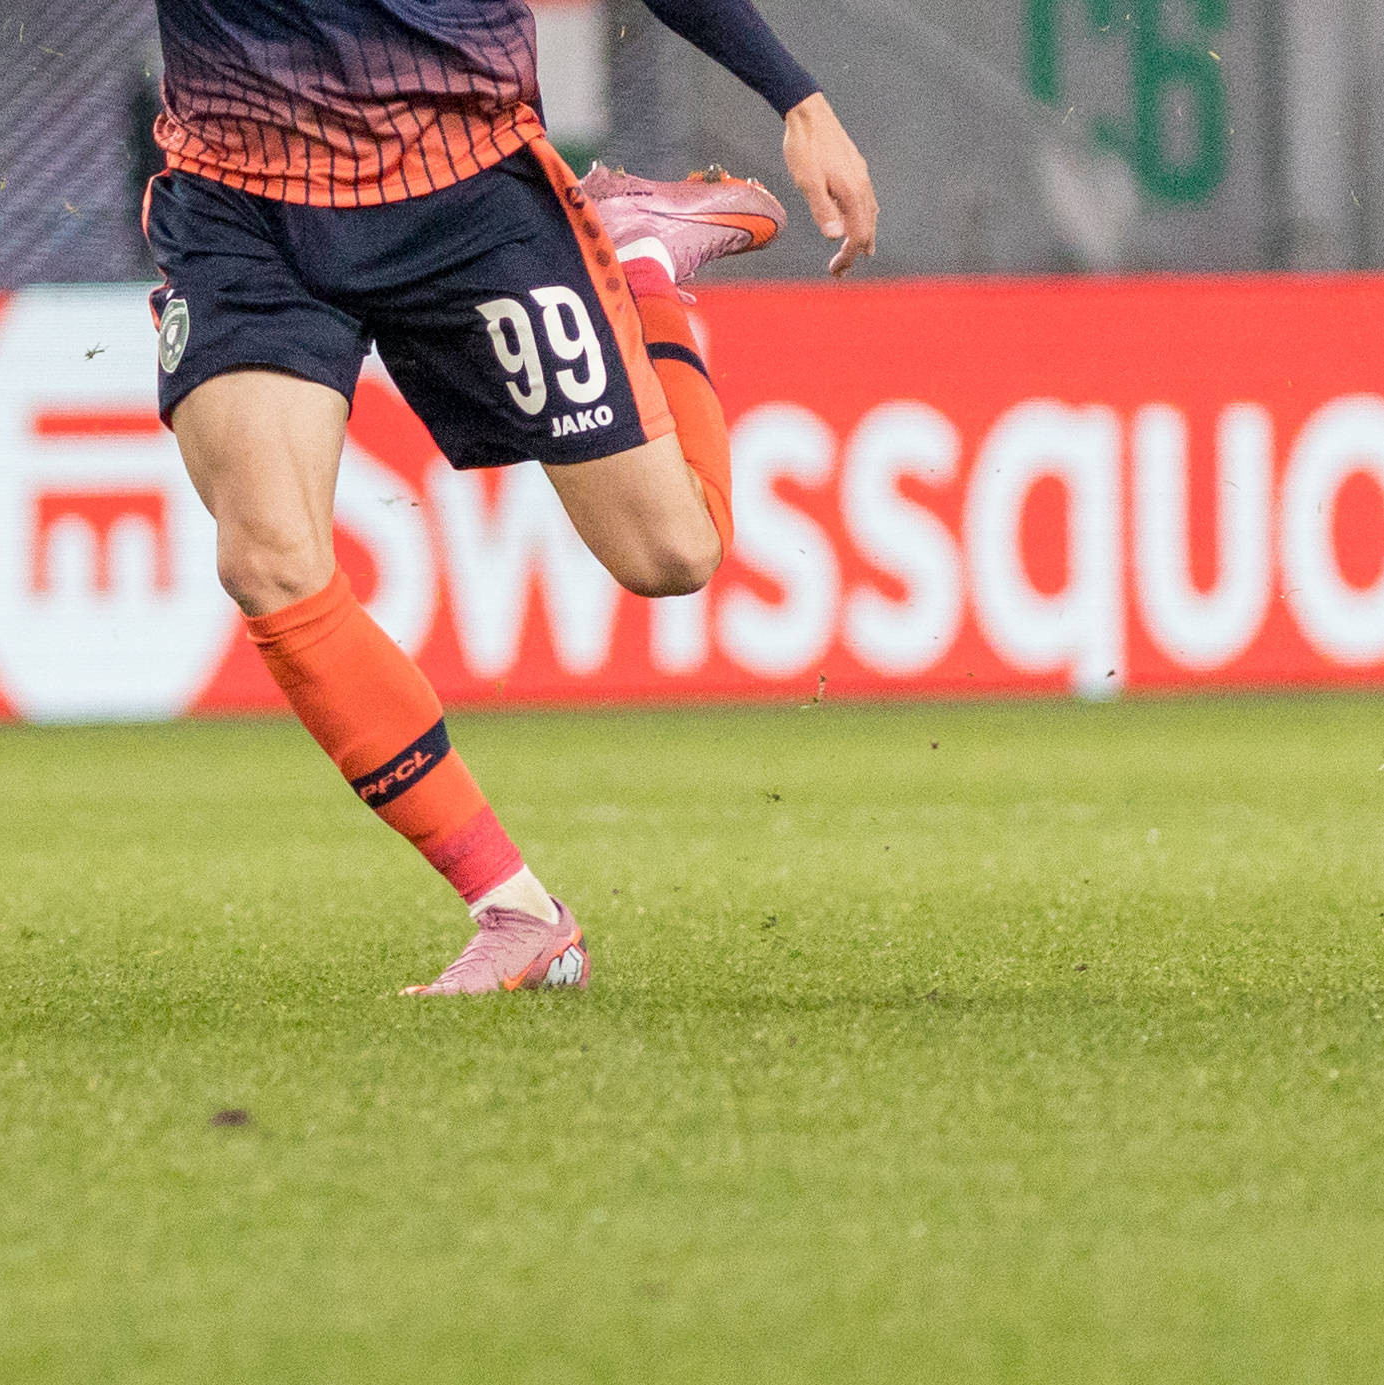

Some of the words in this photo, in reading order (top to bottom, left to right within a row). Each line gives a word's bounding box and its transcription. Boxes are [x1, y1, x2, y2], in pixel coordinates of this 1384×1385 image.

[475, 285, 607, 416] 99
[551, 405, 614, 437] JAKO
[360, 750, 433, 800] PFCL
